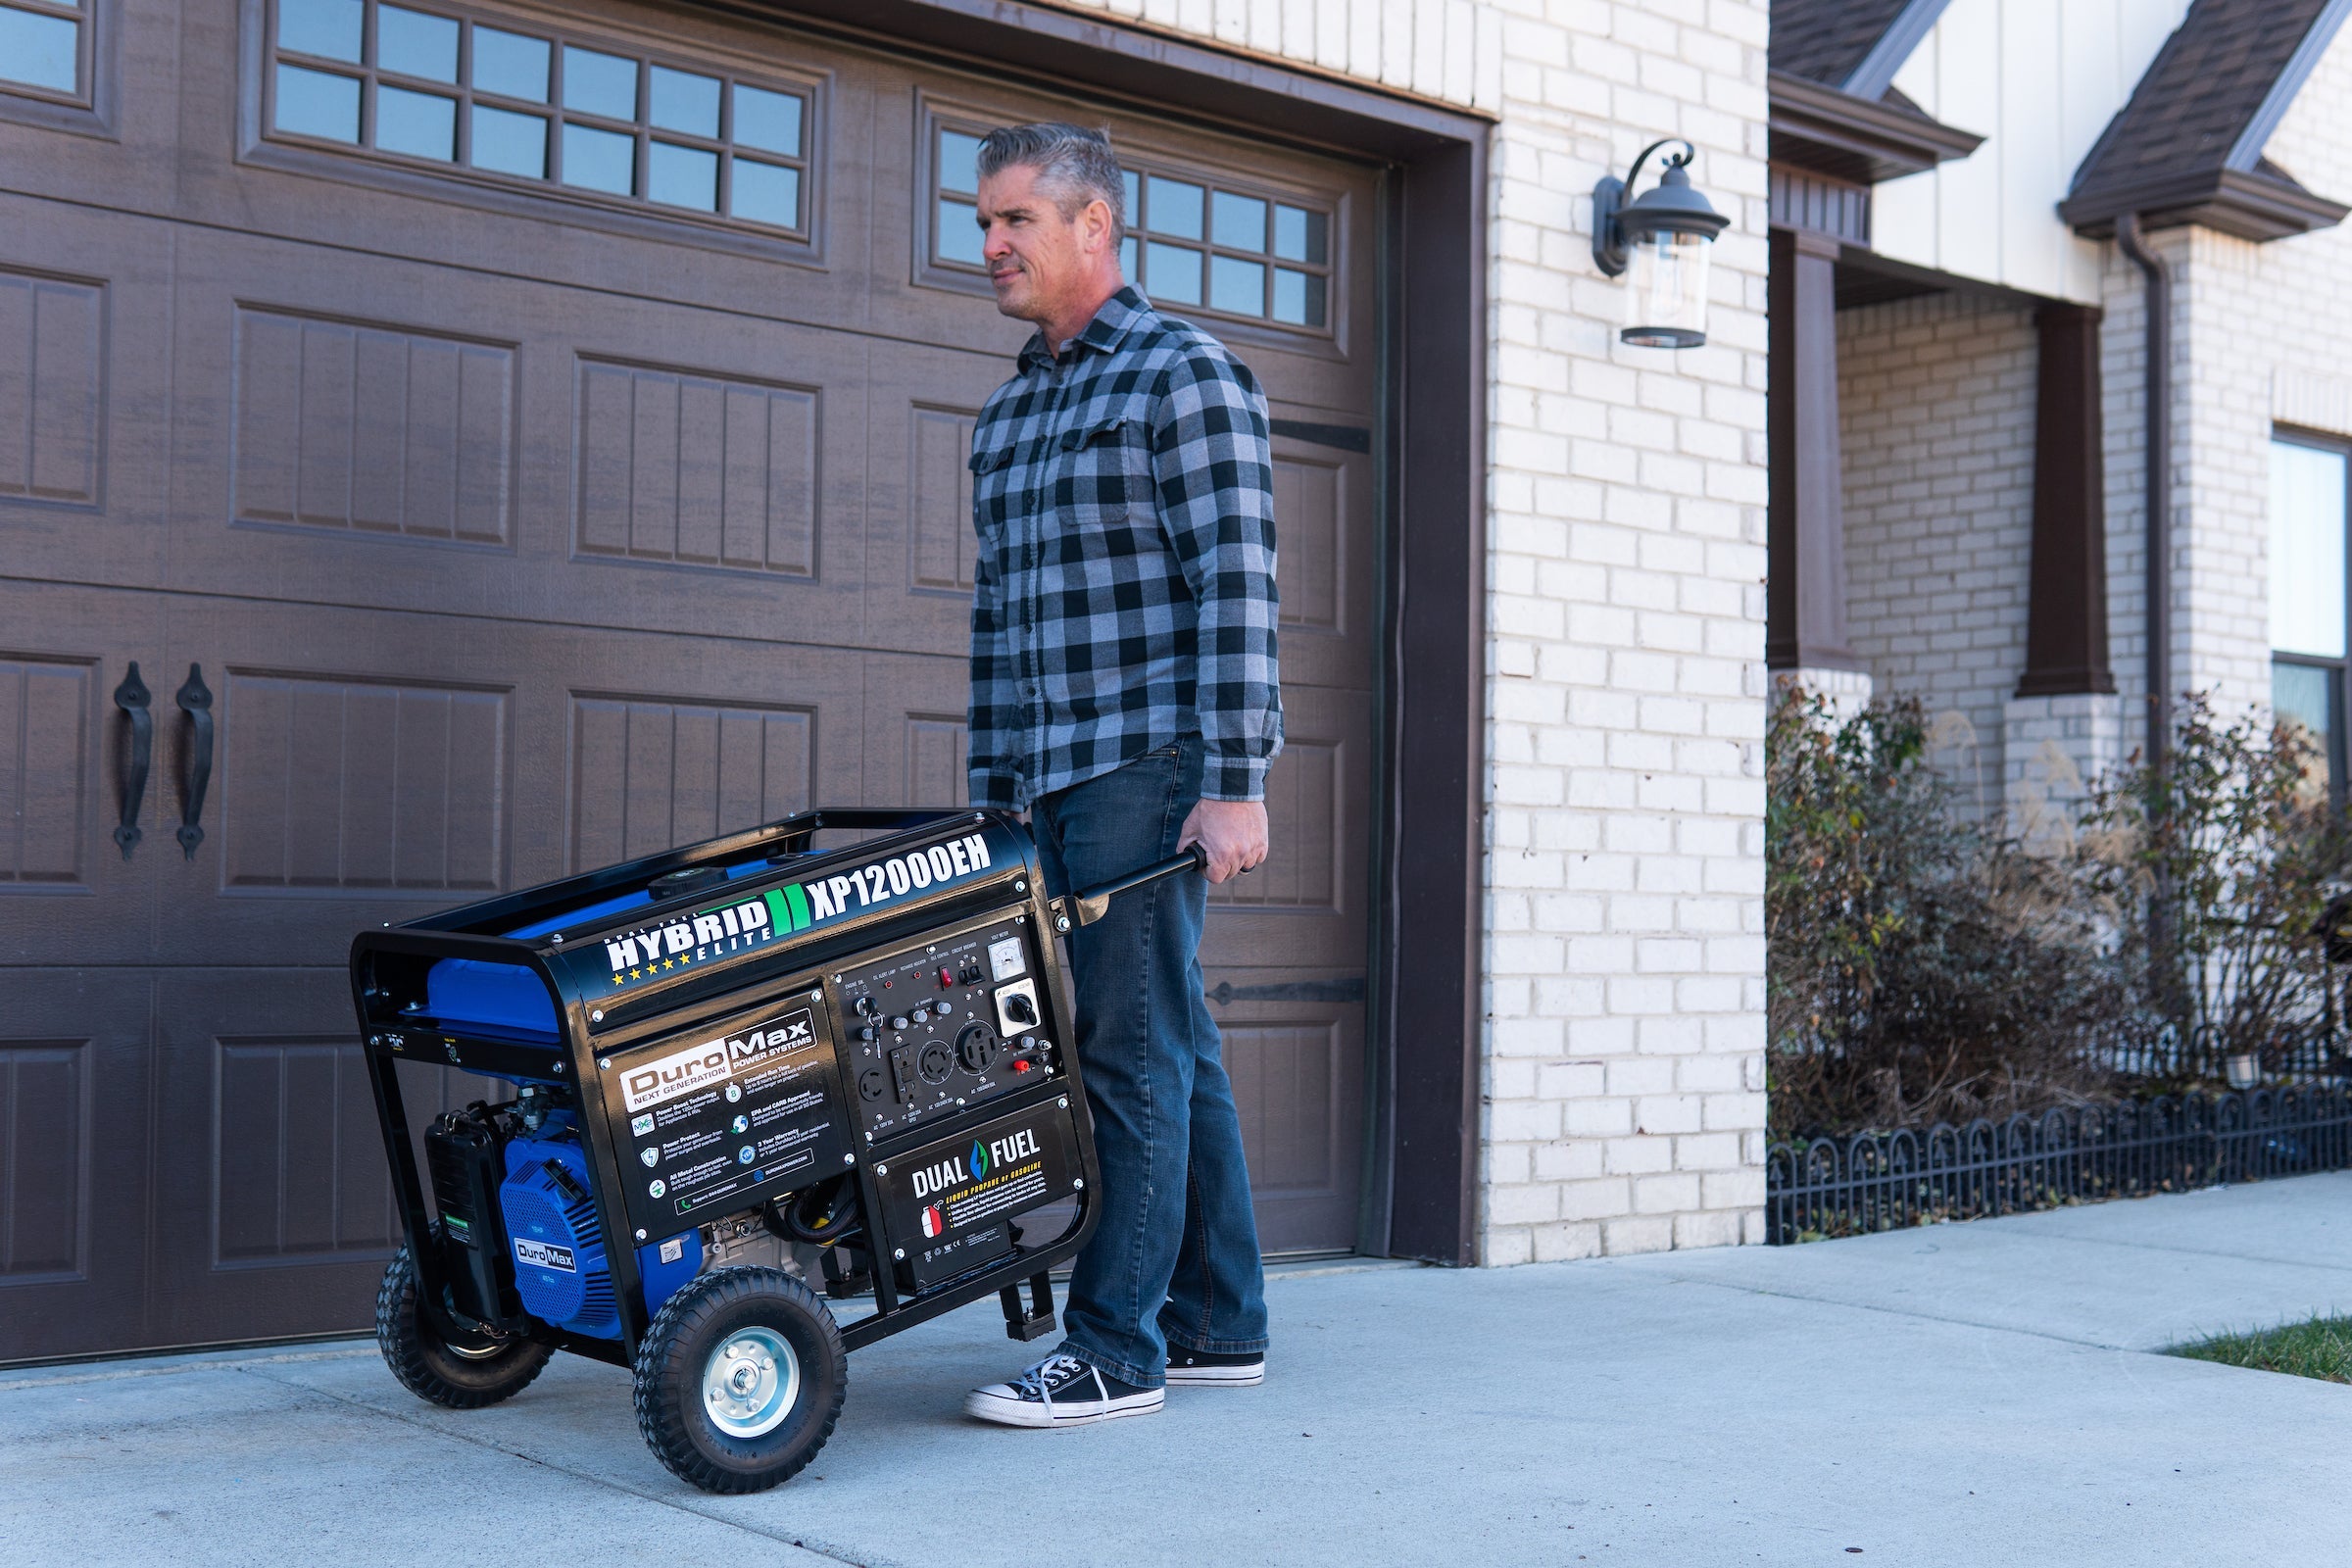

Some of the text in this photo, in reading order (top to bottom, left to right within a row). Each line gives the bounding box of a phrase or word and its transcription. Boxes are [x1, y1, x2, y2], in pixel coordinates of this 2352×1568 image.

[607, 833, 991, 971] HYBRID XP12000EH
[604, 928, 645, 944] DUAL
[697, 927, 771, 960] ELITE
[629, 1021, 809, 1095] DuroMax
[733, 1036, 812, 1070] POWER SYSTEMS
[634, 1066, 726, 1104] NEXT GENERATION
[771, 1099, 787, 1107] CARB
[787, 1090, 810, 1102] Approved
[656, 1091, 716, 1116] Power Boost Technology
[662, 1132, 700, 1149] Power Protect
[773, 1129, 799, 1140] Warranty
[677, 1167, 693, 1177] Metal
[693, 1155, 726, 1171] Construction
[912, 1129, 1041, 1199] DUAL FUEL
[946, 1189, 968, 1203] LIQUID
[970, 1178, 999, 1195] PROPANE
[1010, 1160, 1041, 1178] GASOLINE
[518, 1244, 572, 1266] DuroMax
